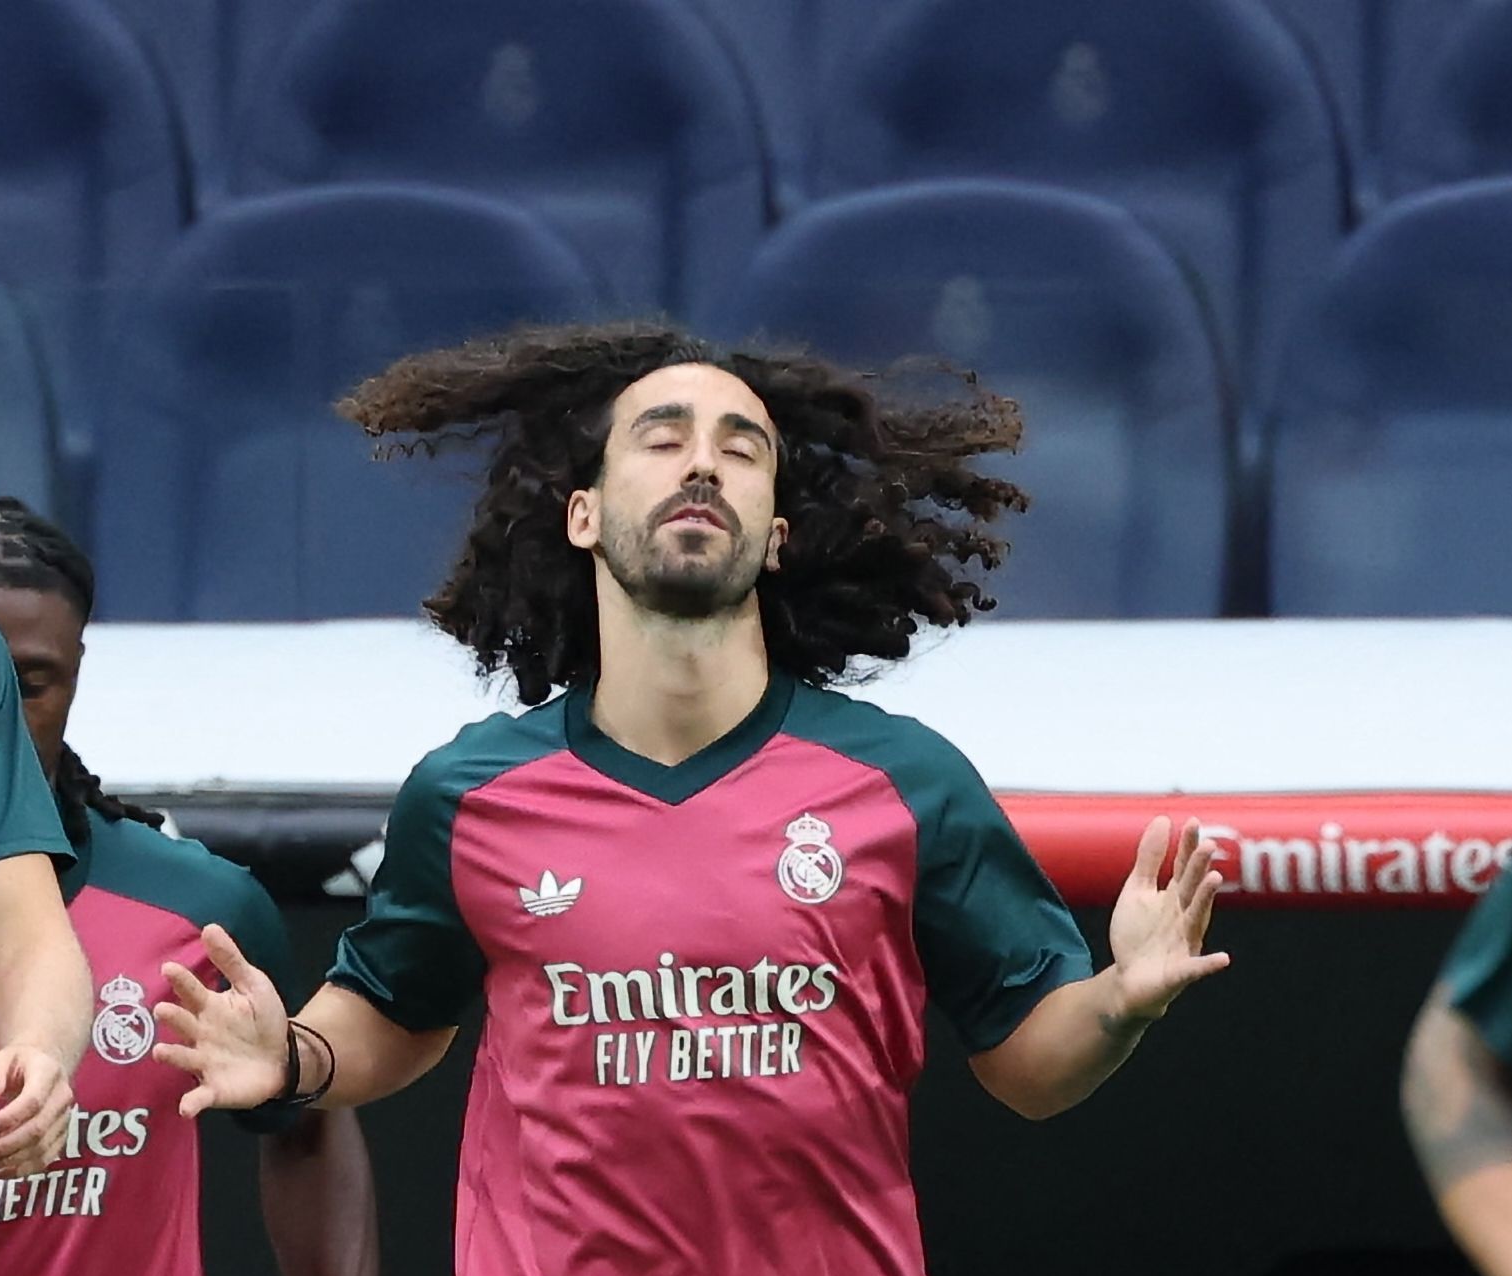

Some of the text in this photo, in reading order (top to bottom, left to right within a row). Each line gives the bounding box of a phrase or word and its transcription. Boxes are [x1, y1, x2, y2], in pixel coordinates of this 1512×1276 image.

[543, 952, 839, 1026] Emirates
[595, 1022, 802, 1086] FLY BETTER
